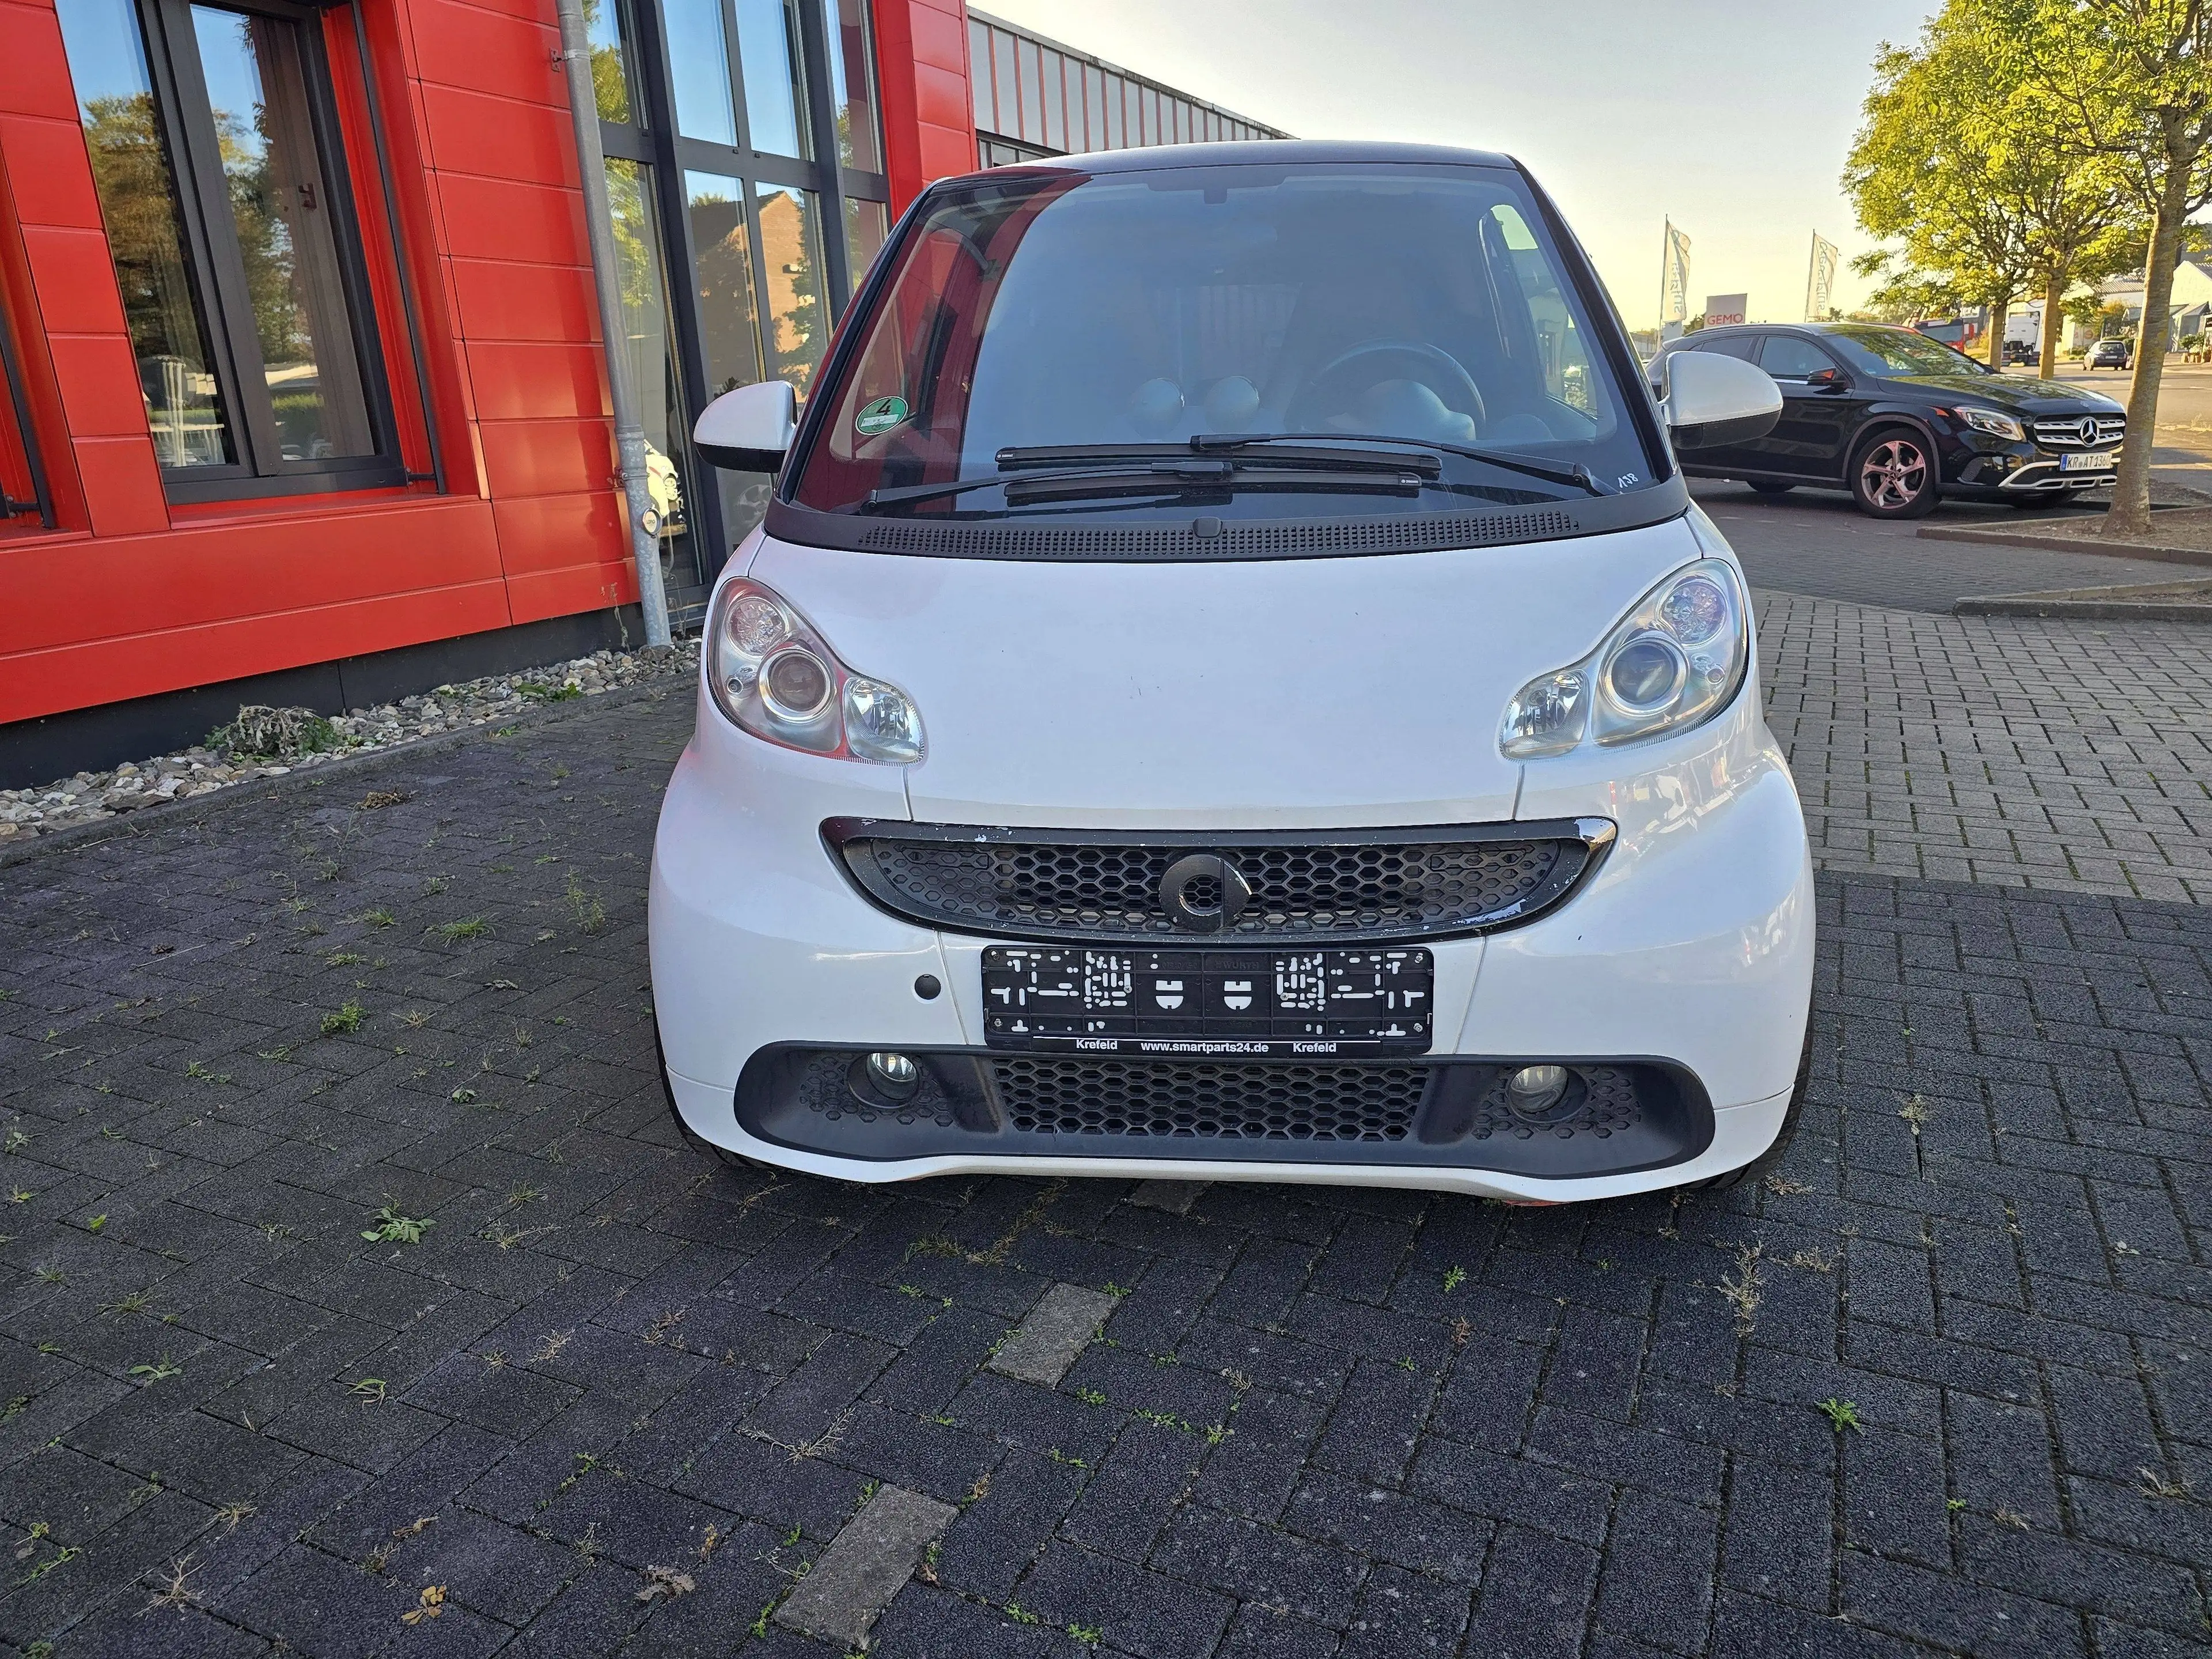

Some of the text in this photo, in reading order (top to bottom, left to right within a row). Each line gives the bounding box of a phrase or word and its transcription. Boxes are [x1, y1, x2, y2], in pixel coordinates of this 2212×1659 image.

[1707, 313, 1743, 325] GEMO
[876, 399, 892, 415] 4
[2067, 456, 2078, 468] KR
[1076, 1039, 1336, 1054] Krefeld www.smartparts24.de Krefeld
